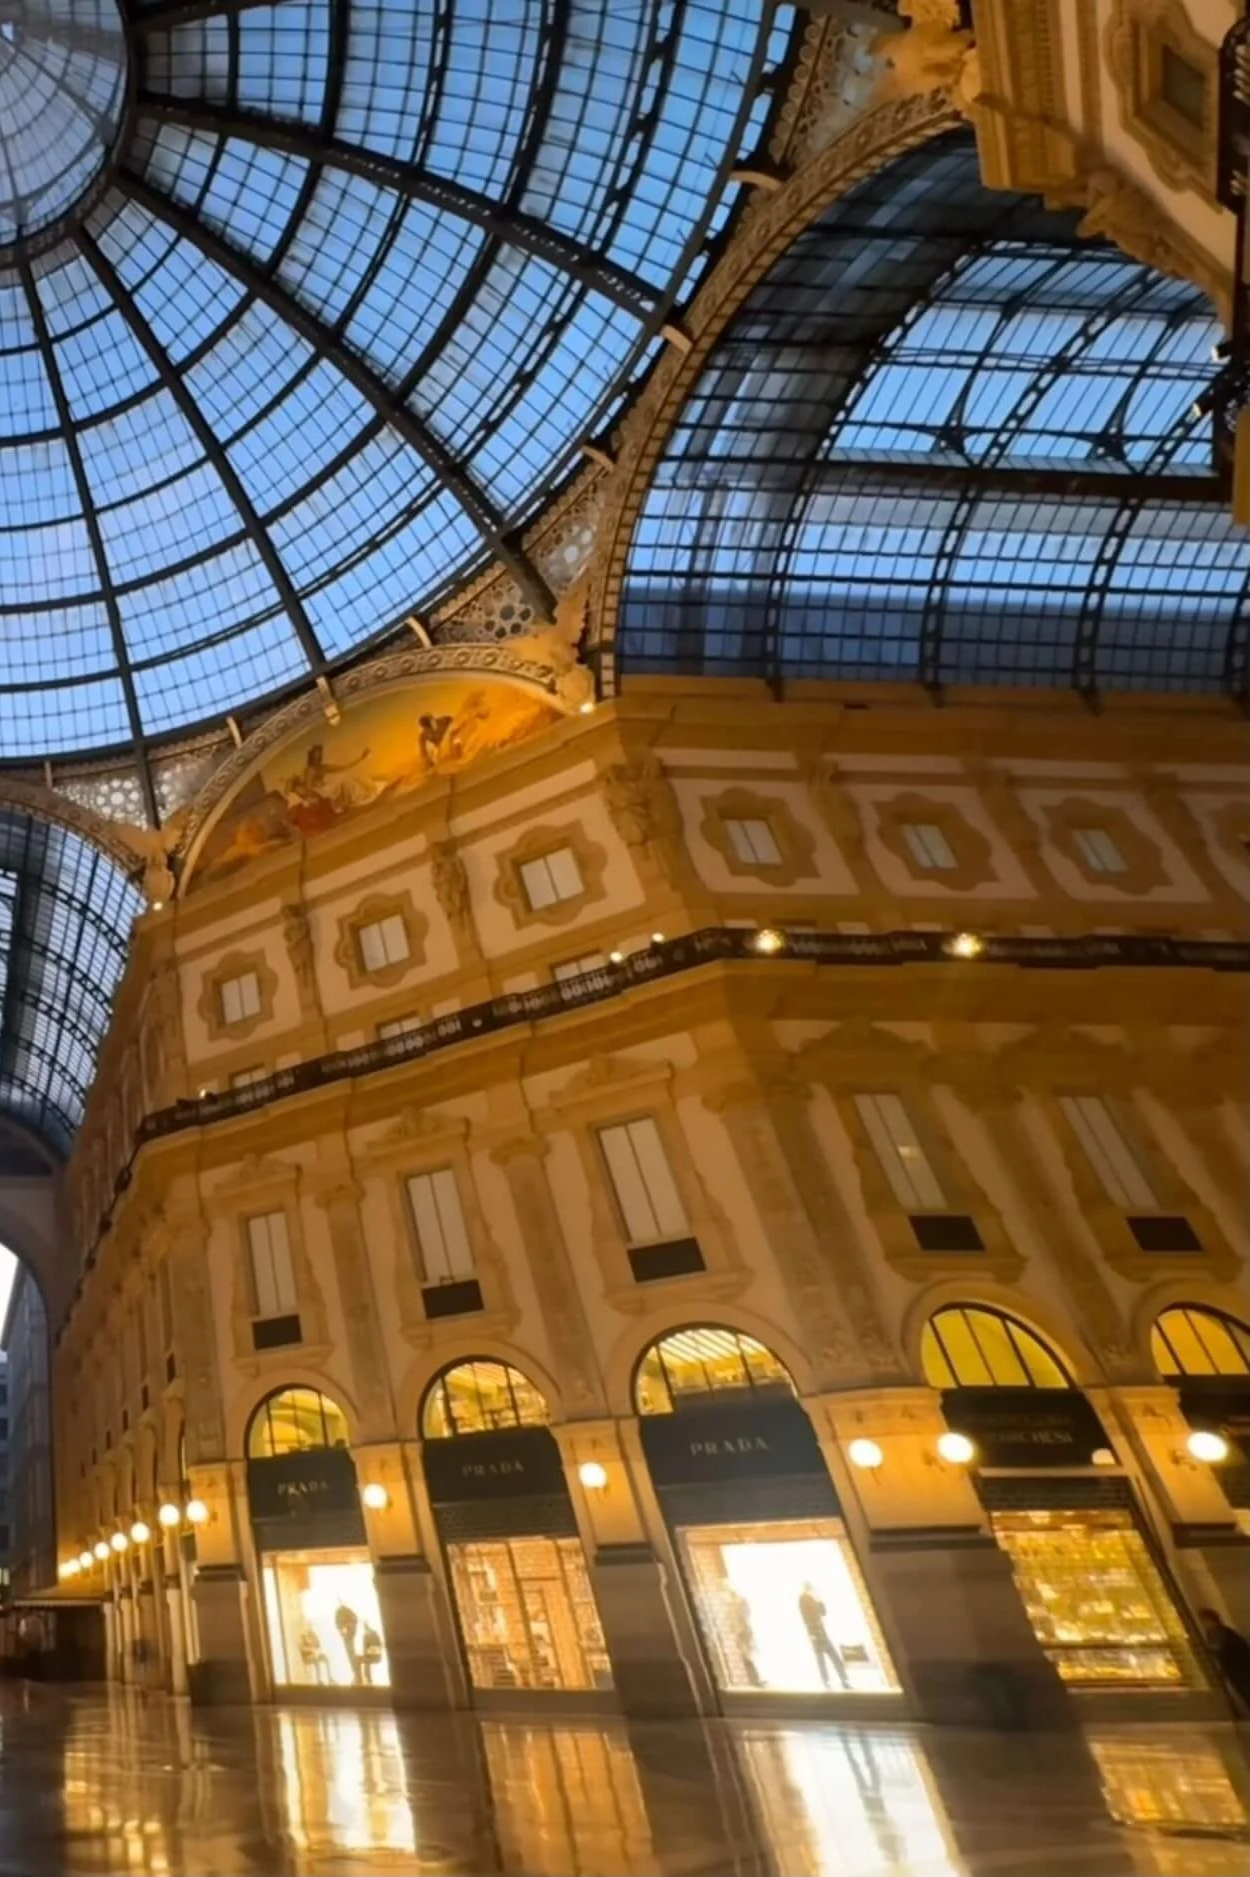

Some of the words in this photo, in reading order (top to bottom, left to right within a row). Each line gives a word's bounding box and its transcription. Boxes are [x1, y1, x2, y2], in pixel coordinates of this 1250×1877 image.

[689, 1436, 770, 1456] PRADA
[462, 1459, 525, 1477] PRADA
[277, 1480, 329, 1497] PRADA
